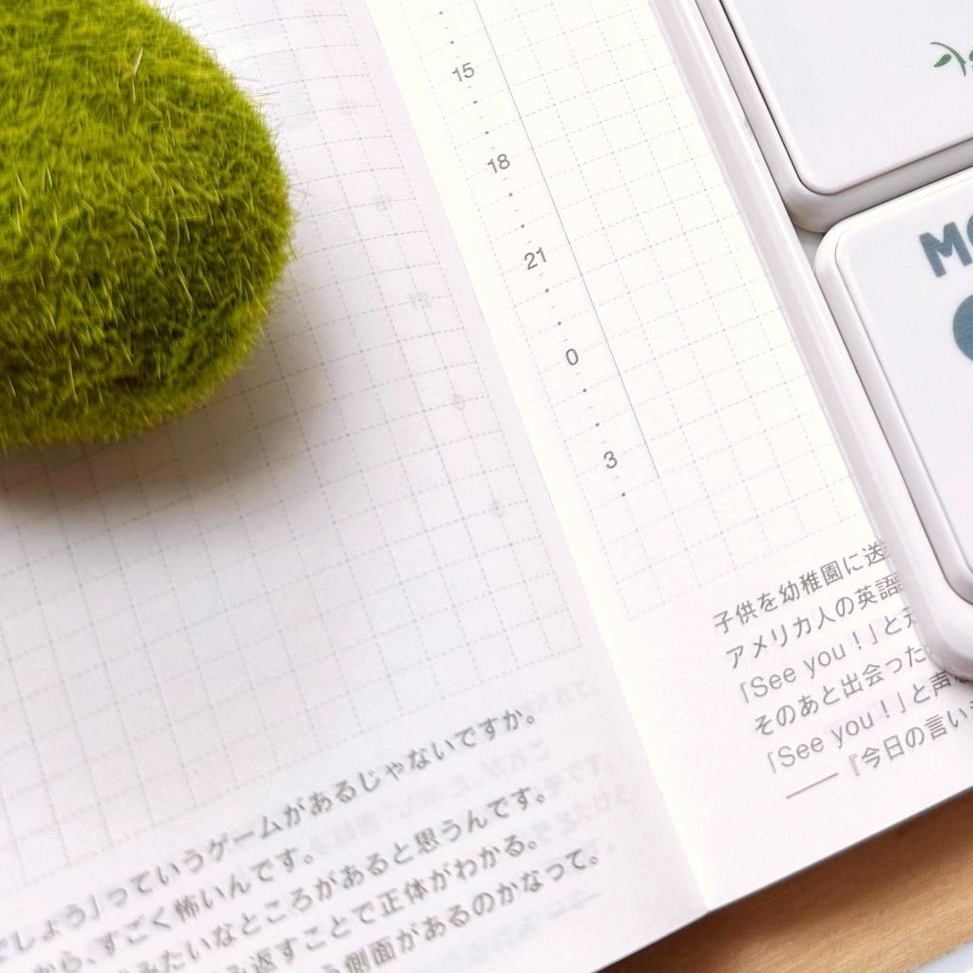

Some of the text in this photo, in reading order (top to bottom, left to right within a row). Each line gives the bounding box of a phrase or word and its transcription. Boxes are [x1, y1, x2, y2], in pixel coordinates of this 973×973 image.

[452, 62, 475, 83] 15
[487, 153, 511, 174] 18
[524, 247, 548, 271] 21
[565, 348, 579, 366] 0
[603, 451, 618, 469] 3
[711, 540, 888, 635] 子供を幼稚園に送
[725, 572, 903, 670] アメリカ人の英語
[753, 643, 928, 738] そのあと出会った
